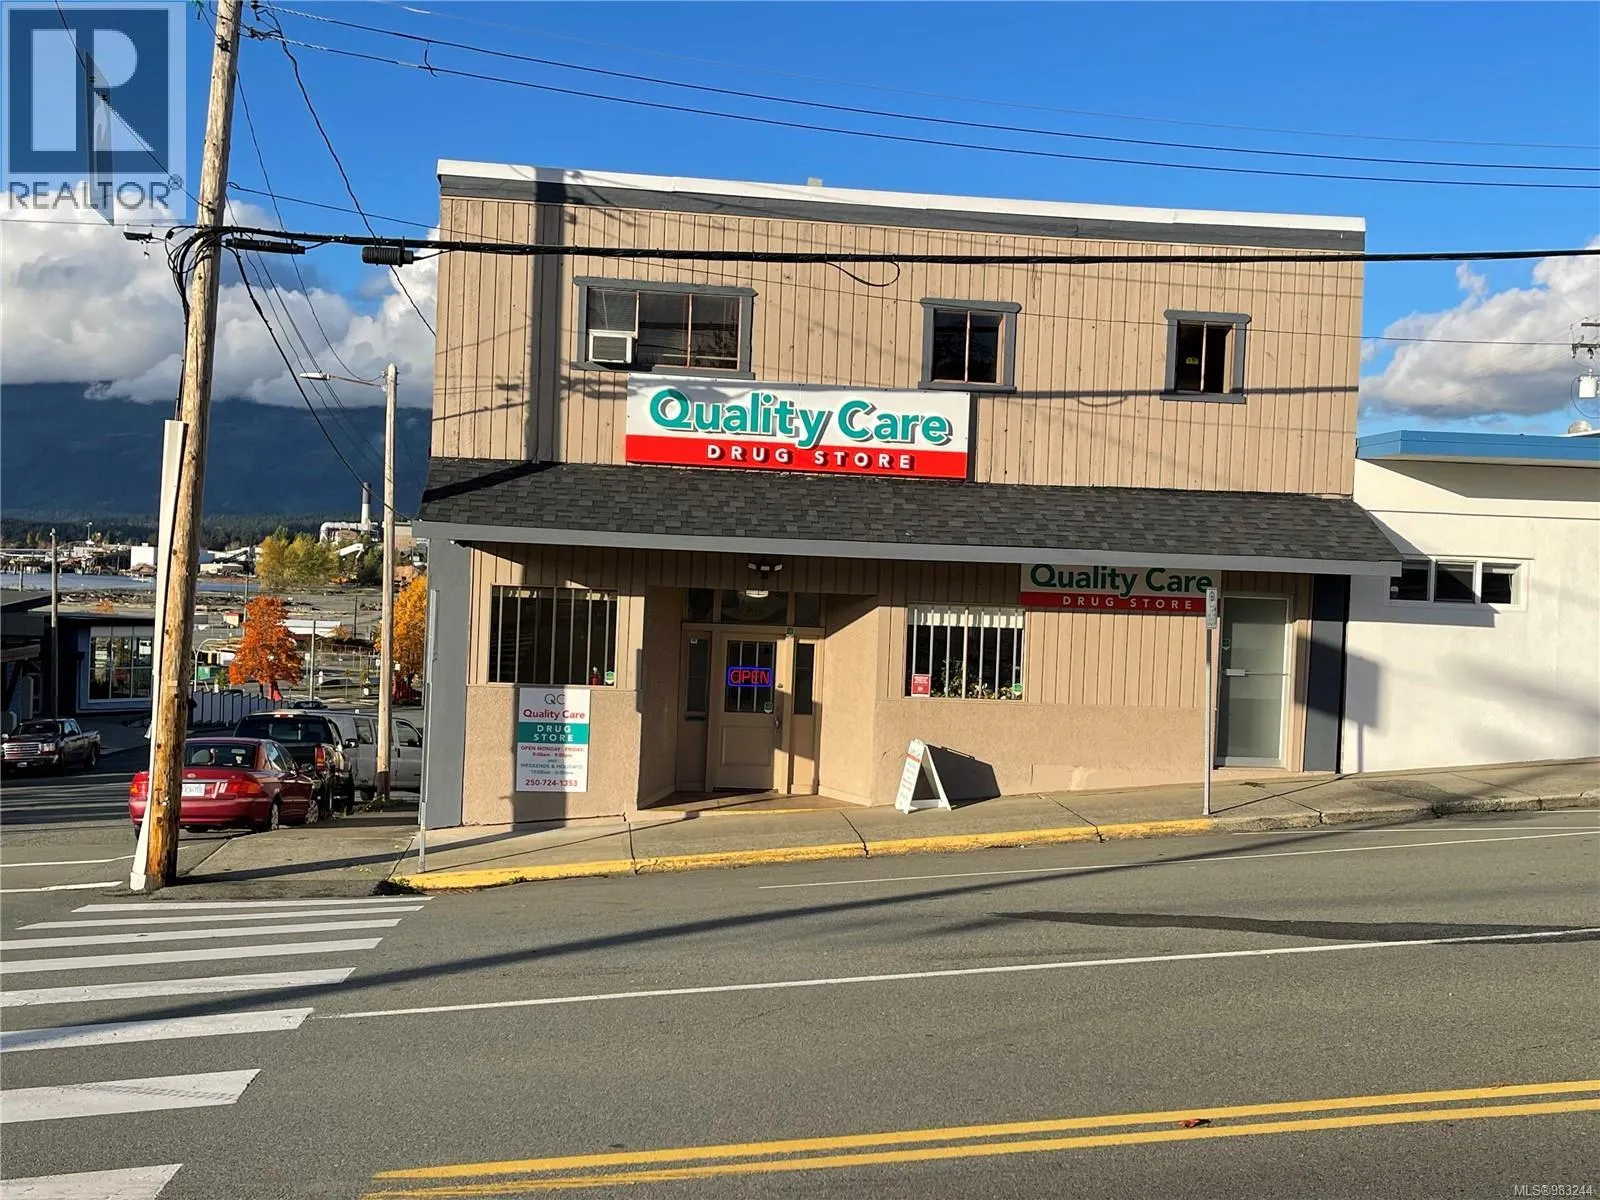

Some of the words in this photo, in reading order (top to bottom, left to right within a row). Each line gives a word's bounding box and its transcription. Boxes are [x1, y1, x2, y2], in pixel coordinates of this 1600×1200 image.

[650, 388, 829, 448] Quality
[837, 400, 951, 445] Care
[706, 445, 792, 464] DRUG
[814, 450, 914, 471] STORE
[1030, 563, 1138, 598] Quality
[1145, 567, 1212, 593] Care
[1062, 596, 1114, 607] DRUG
[1130, 598, 1192, 610] STORE
[730, 669, 770, 684] OPEN
[544, 693, 566, 705] QC
[523, 708, 561, 721] Quality
[562, 709, 586, 719] Care
[537, 724, 572, 733] DRUG
[533, 733, 574, 742] STORE
